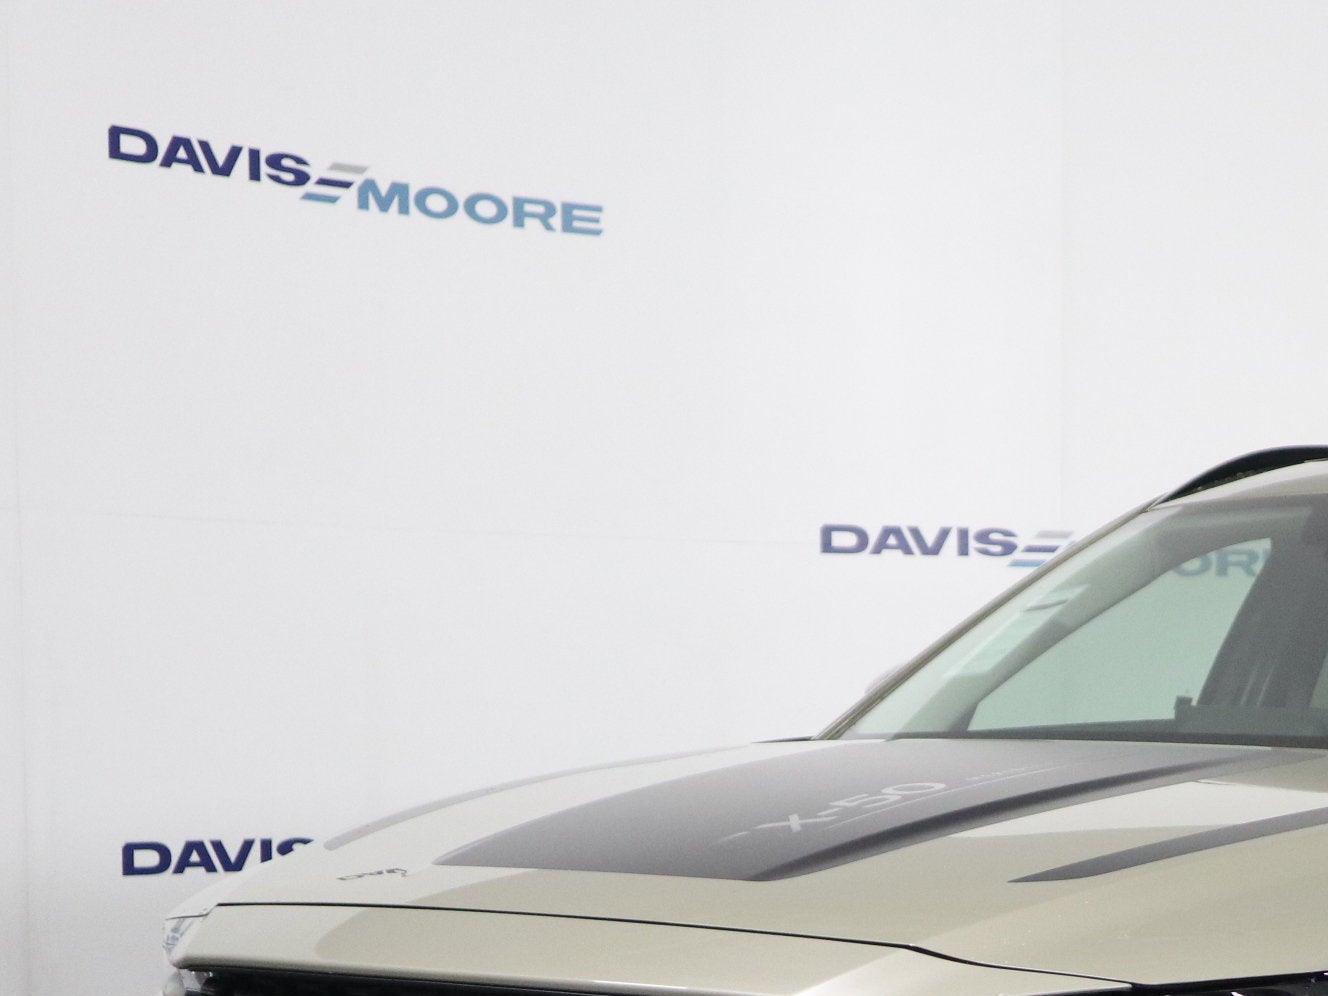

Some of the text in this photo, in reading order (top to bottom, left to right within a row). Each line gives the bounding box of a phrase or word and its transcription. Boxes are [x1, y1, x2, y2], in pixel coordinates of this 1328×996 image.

[108, 124, 605, 237] DAVIS MOORE
[820, 524, 1018, 557] DAVIS
